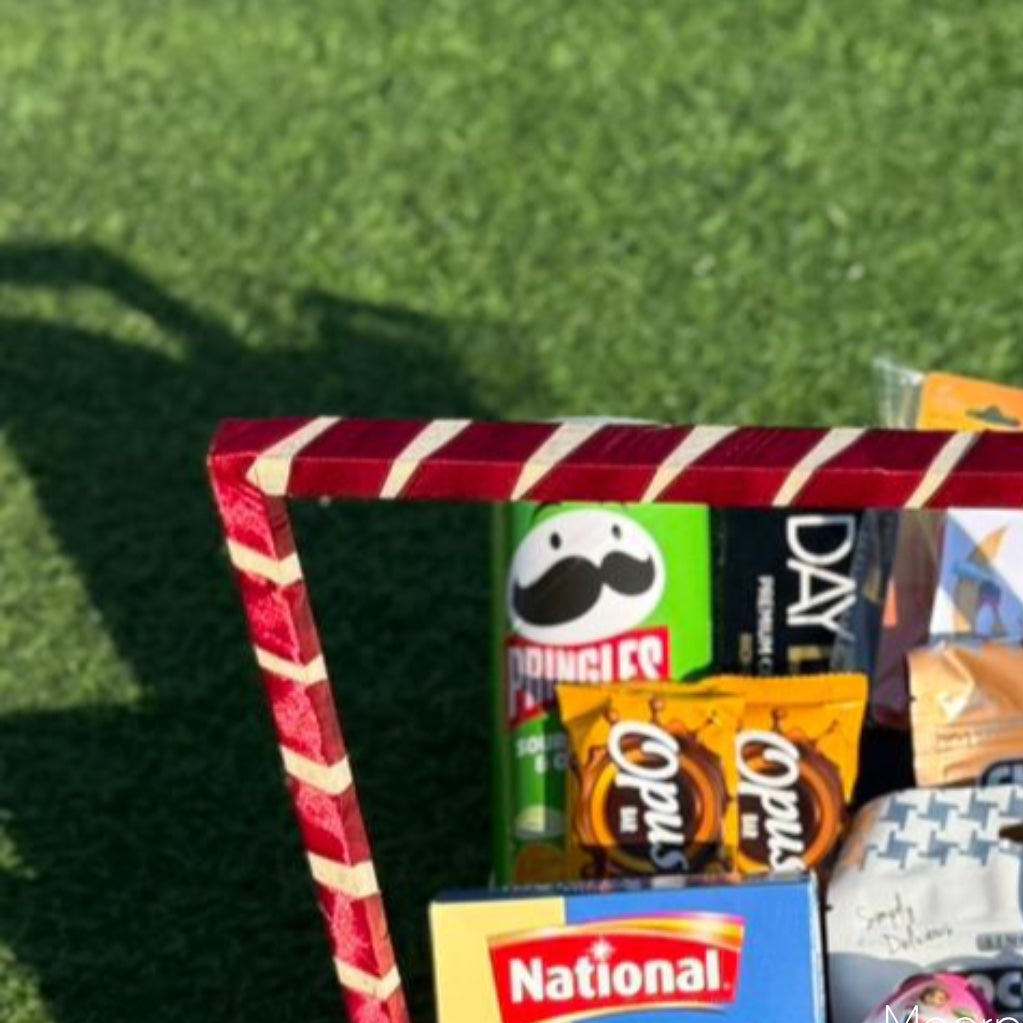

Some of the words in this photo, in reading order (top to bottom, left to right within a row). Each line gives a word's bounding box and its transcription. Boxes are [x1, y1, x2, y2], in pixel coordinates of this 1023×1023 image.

[786, 515, 857, 642] DAY
[608, 720, 689, 871] Opus
[736, 730, 806, 872] Opus
[508, 939, 722, 1004] National
